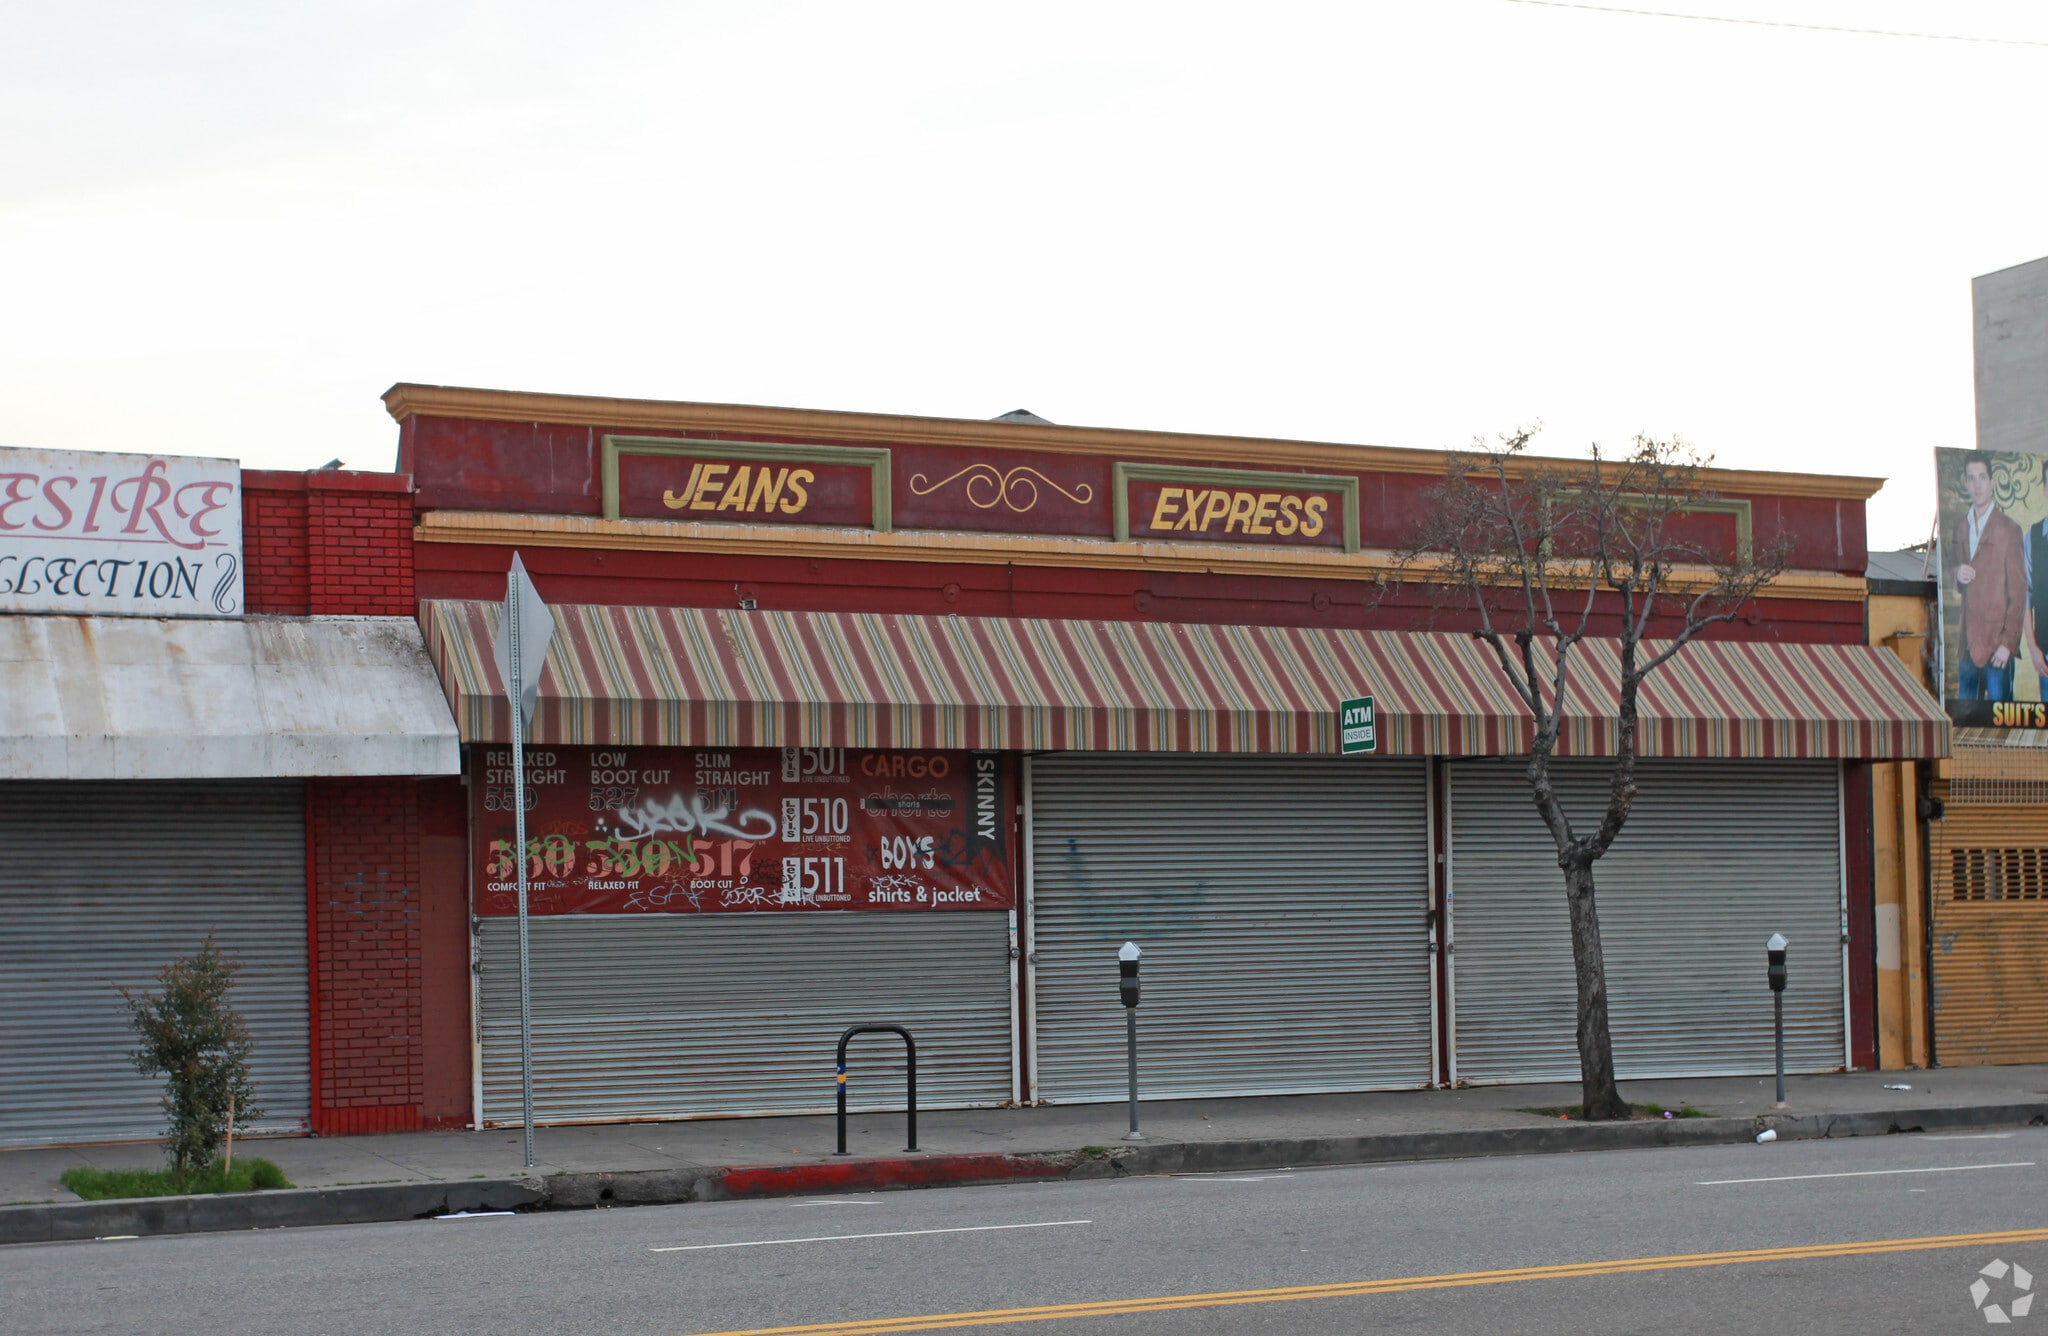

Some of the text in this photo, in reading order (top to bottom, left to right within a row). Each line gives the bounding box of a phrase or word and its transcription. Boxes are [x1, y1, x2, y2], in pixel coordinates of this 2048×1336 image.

[663, 463, 815, 515] JEANS
[0, 460, 234, 550] ESIRE
[1150, 487, 1329, 538] EXPRESS
[1344, 706, 1372, 726] ATM
[1992, 701, 2047, 728] SUIT'S
[1345, 728, 1372, 741] INSIDE
[486, 752, 557, 767] RELXED
[591, 752, 627, 767] LOW
[695, 753, 731, 768] SLIM
[803, 748, 845, 775] 501
[861, 754, 950, 778] CARGO
[486, 769, 567, 785] STRIGHT
[591, 770, 671, 785] BOOT CUT
[695, 771, 771, 786] STRAIGHT
[589, 787, 639, 811] 527
[897, 800, 921, 808] shorts
[976, 759, 996, 841] SKINNY
[803, 798, 849, 834] 510
[802, 835, 851, 843] LIVE UNBUTTONED
[690, 839, 756, 877] 517
[881, 835, 935, 869] BOYS
[588, 880, 639, 890] RELAXED FIT
[690, 879, 733, 889] BOOT CUT
[803, 857, 844, 894] 511
[487, 882, 531, 892] COMFOT
[534, 882, 546, 891] FIT
[868, 886, 911, 903] shirts
[915, 886, 928, 903] &
[931, 886, 982, 907] jacket
[816, 894, 852, 902] UNBUTTONED
